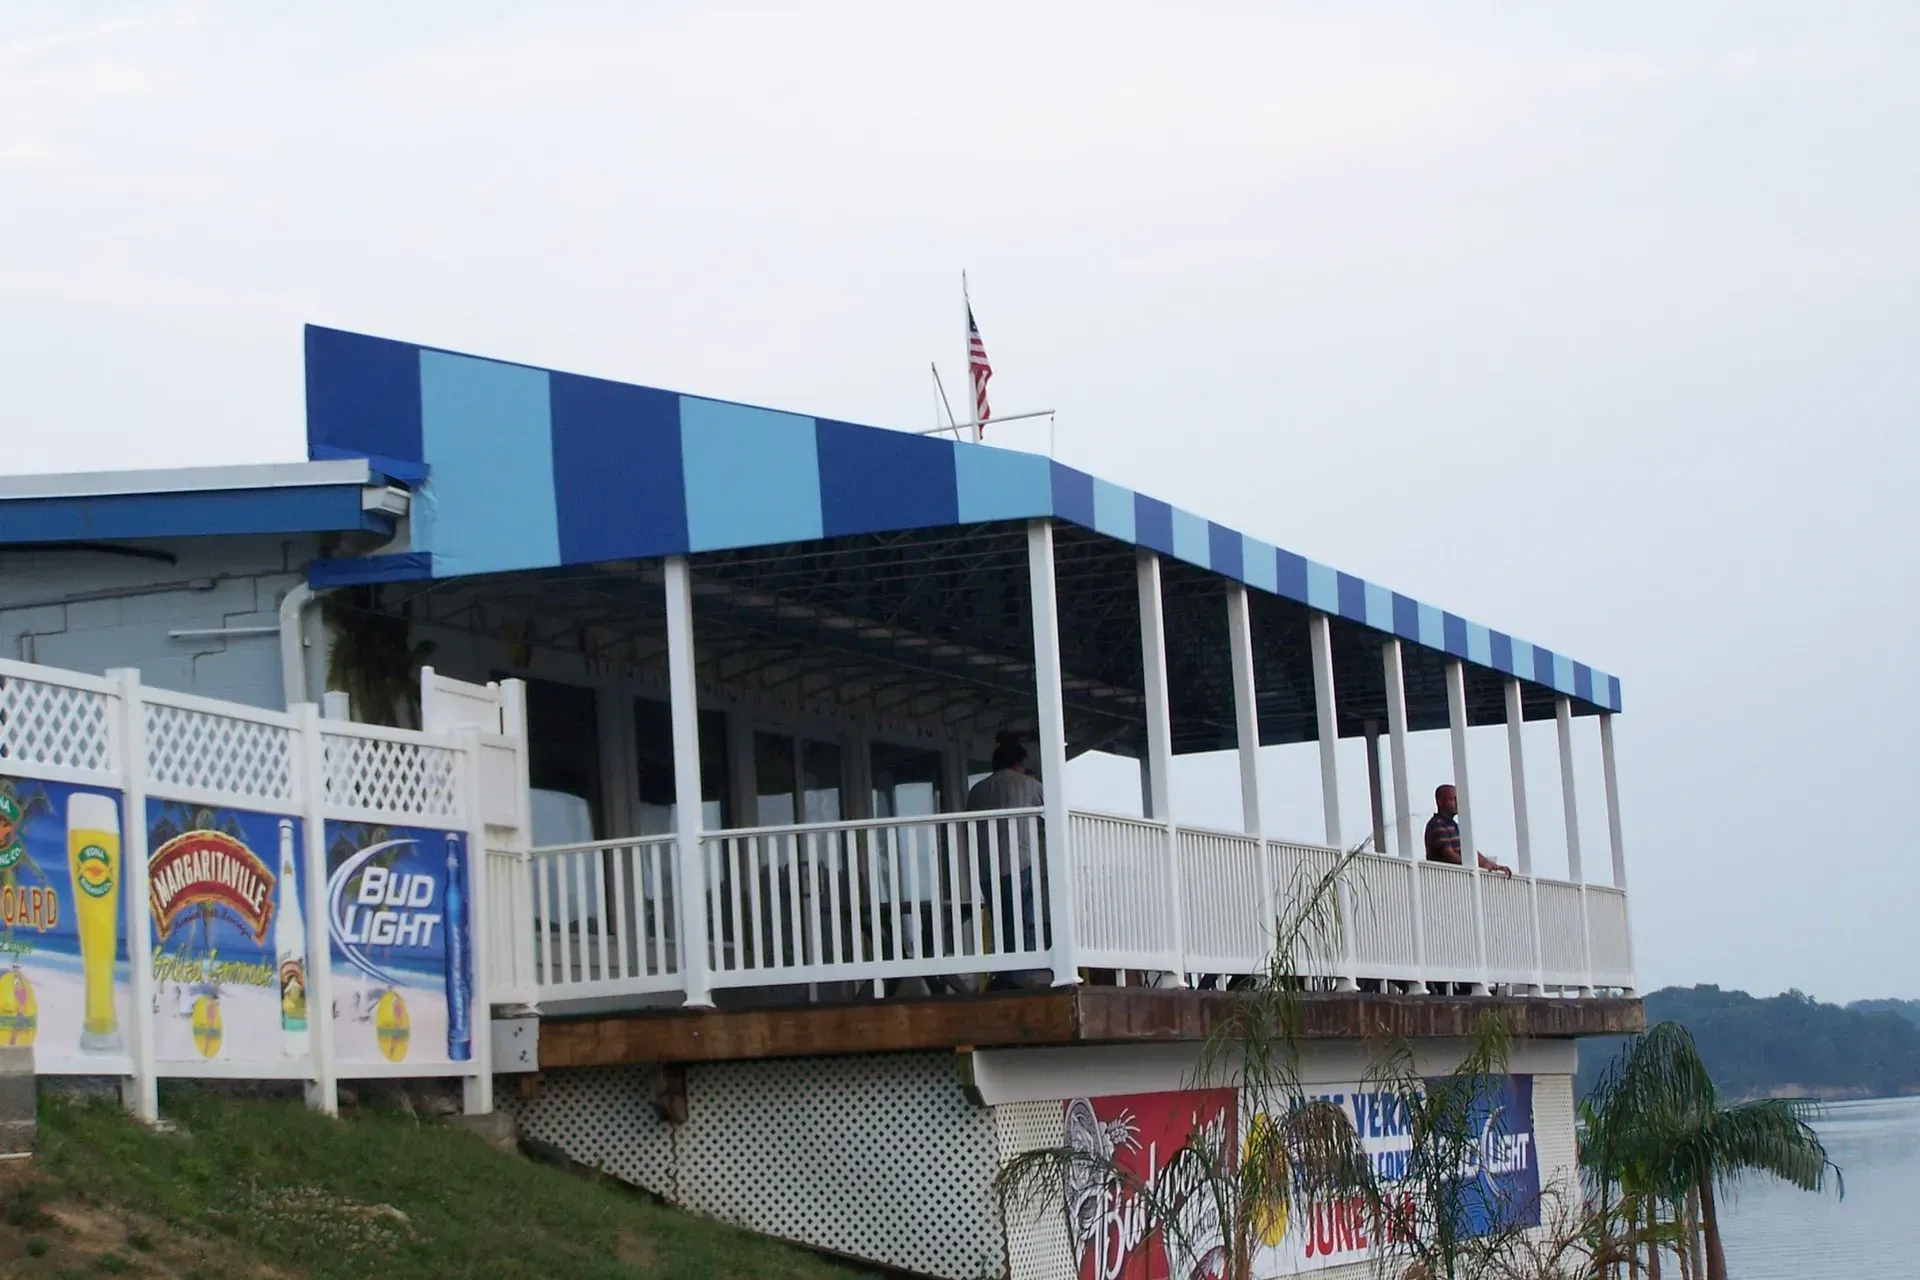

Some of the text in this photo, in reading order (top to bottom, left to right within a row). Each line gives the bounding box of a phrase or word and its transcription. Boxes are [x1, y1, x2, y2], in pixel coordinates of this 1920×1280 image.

[154, 848, 267, 915] MARGARITAVILLE
[358, 866, 435, 909] BUD
[343, 905, 442, 948] LIGHT
[1488, 1130, 1531, 1175] LIGHT
[1305, 1192, 1368, 1258] JUNE
